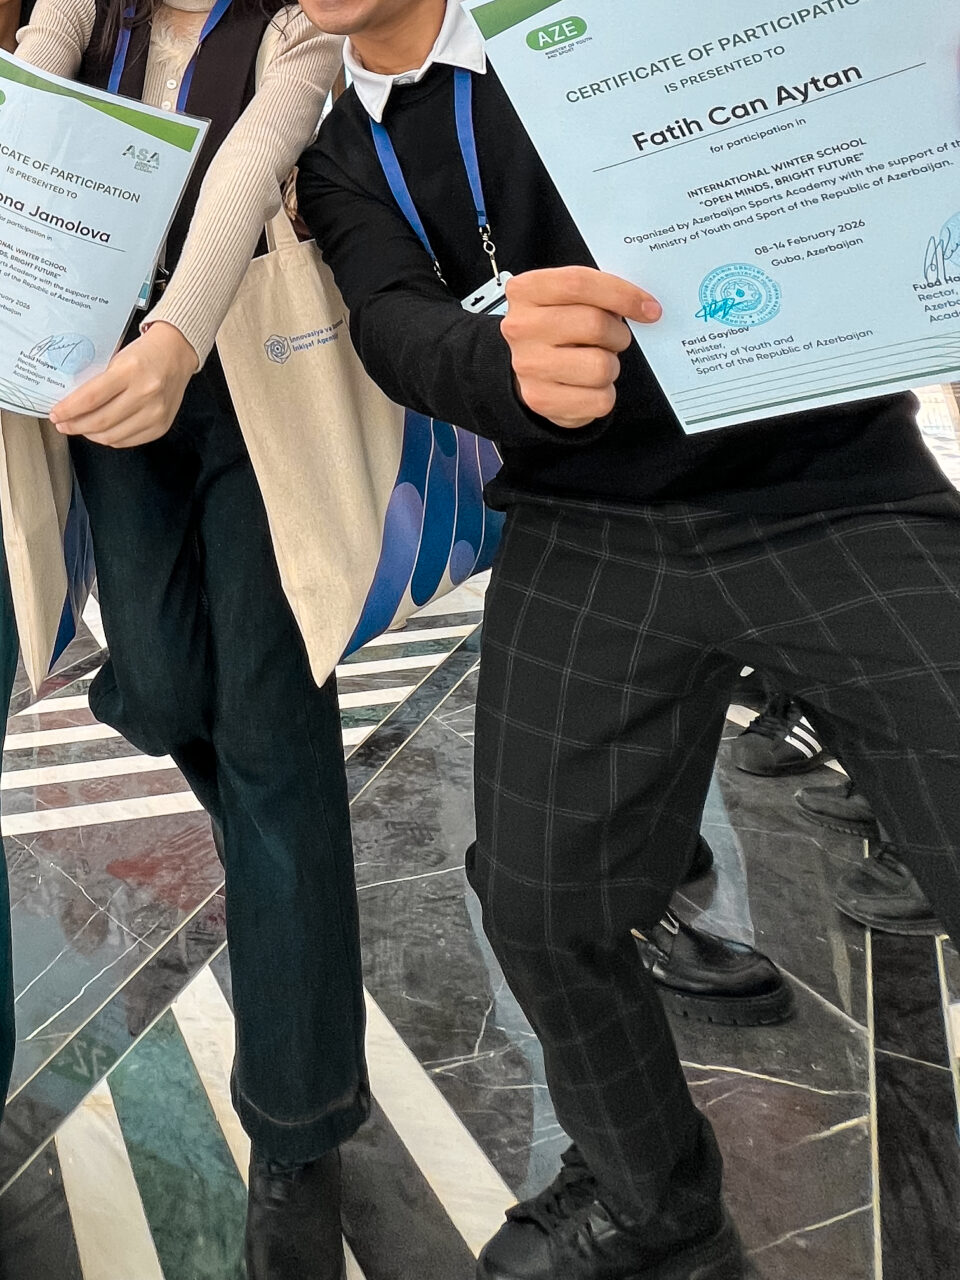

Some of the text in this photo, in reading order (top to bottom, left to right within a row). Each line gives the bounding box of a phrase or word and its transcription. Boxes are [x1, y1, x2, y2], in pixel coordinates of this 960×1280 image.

[538, 21, 578, 47] AZE
[565, 53, 686, 103] CERTIFICATE
[687, 42, 714, 61] OF
[664, 45, 785, 93] IS PRESENTED TO
[632, 66, 862, 151] Fatih Can Aytan
[709, 118, 806, 153] for participation in
[122, 144, 159, 166] ASA
[687, 137, 867, 198] INTERNATIONAL WINTER SCHOOL
[6, 165, 78, 199] IS PRESENTED TO
[33, 160, 50, 172] OF
[50, 166, 140, 203] PARTICIPATION
[623, 140, 960, 244] Organized by Azerbaijan Sports Academy with the support of th
[734, 181, 774, 198] MINDS,
[774, 167, 814, 186] BRIGHT
[28, 205, 111, 243] Jamolova
[648, 160, 954, 252] Ministry of Youth and Sport of the Republic of Azerbaijan.
[754, 218, 866, 255] 08-14 February 2026
[770, 238, 863, 267] Guba, Azerbaijan
[681, 325, 749, 347] Farid Gayibov
[685, 342, 726, 356] Minister,
[690, 335, 794, 365] Ministry of Youth and
[695, 330, 873, 375] Sport of the Republic of Azerbaijan
